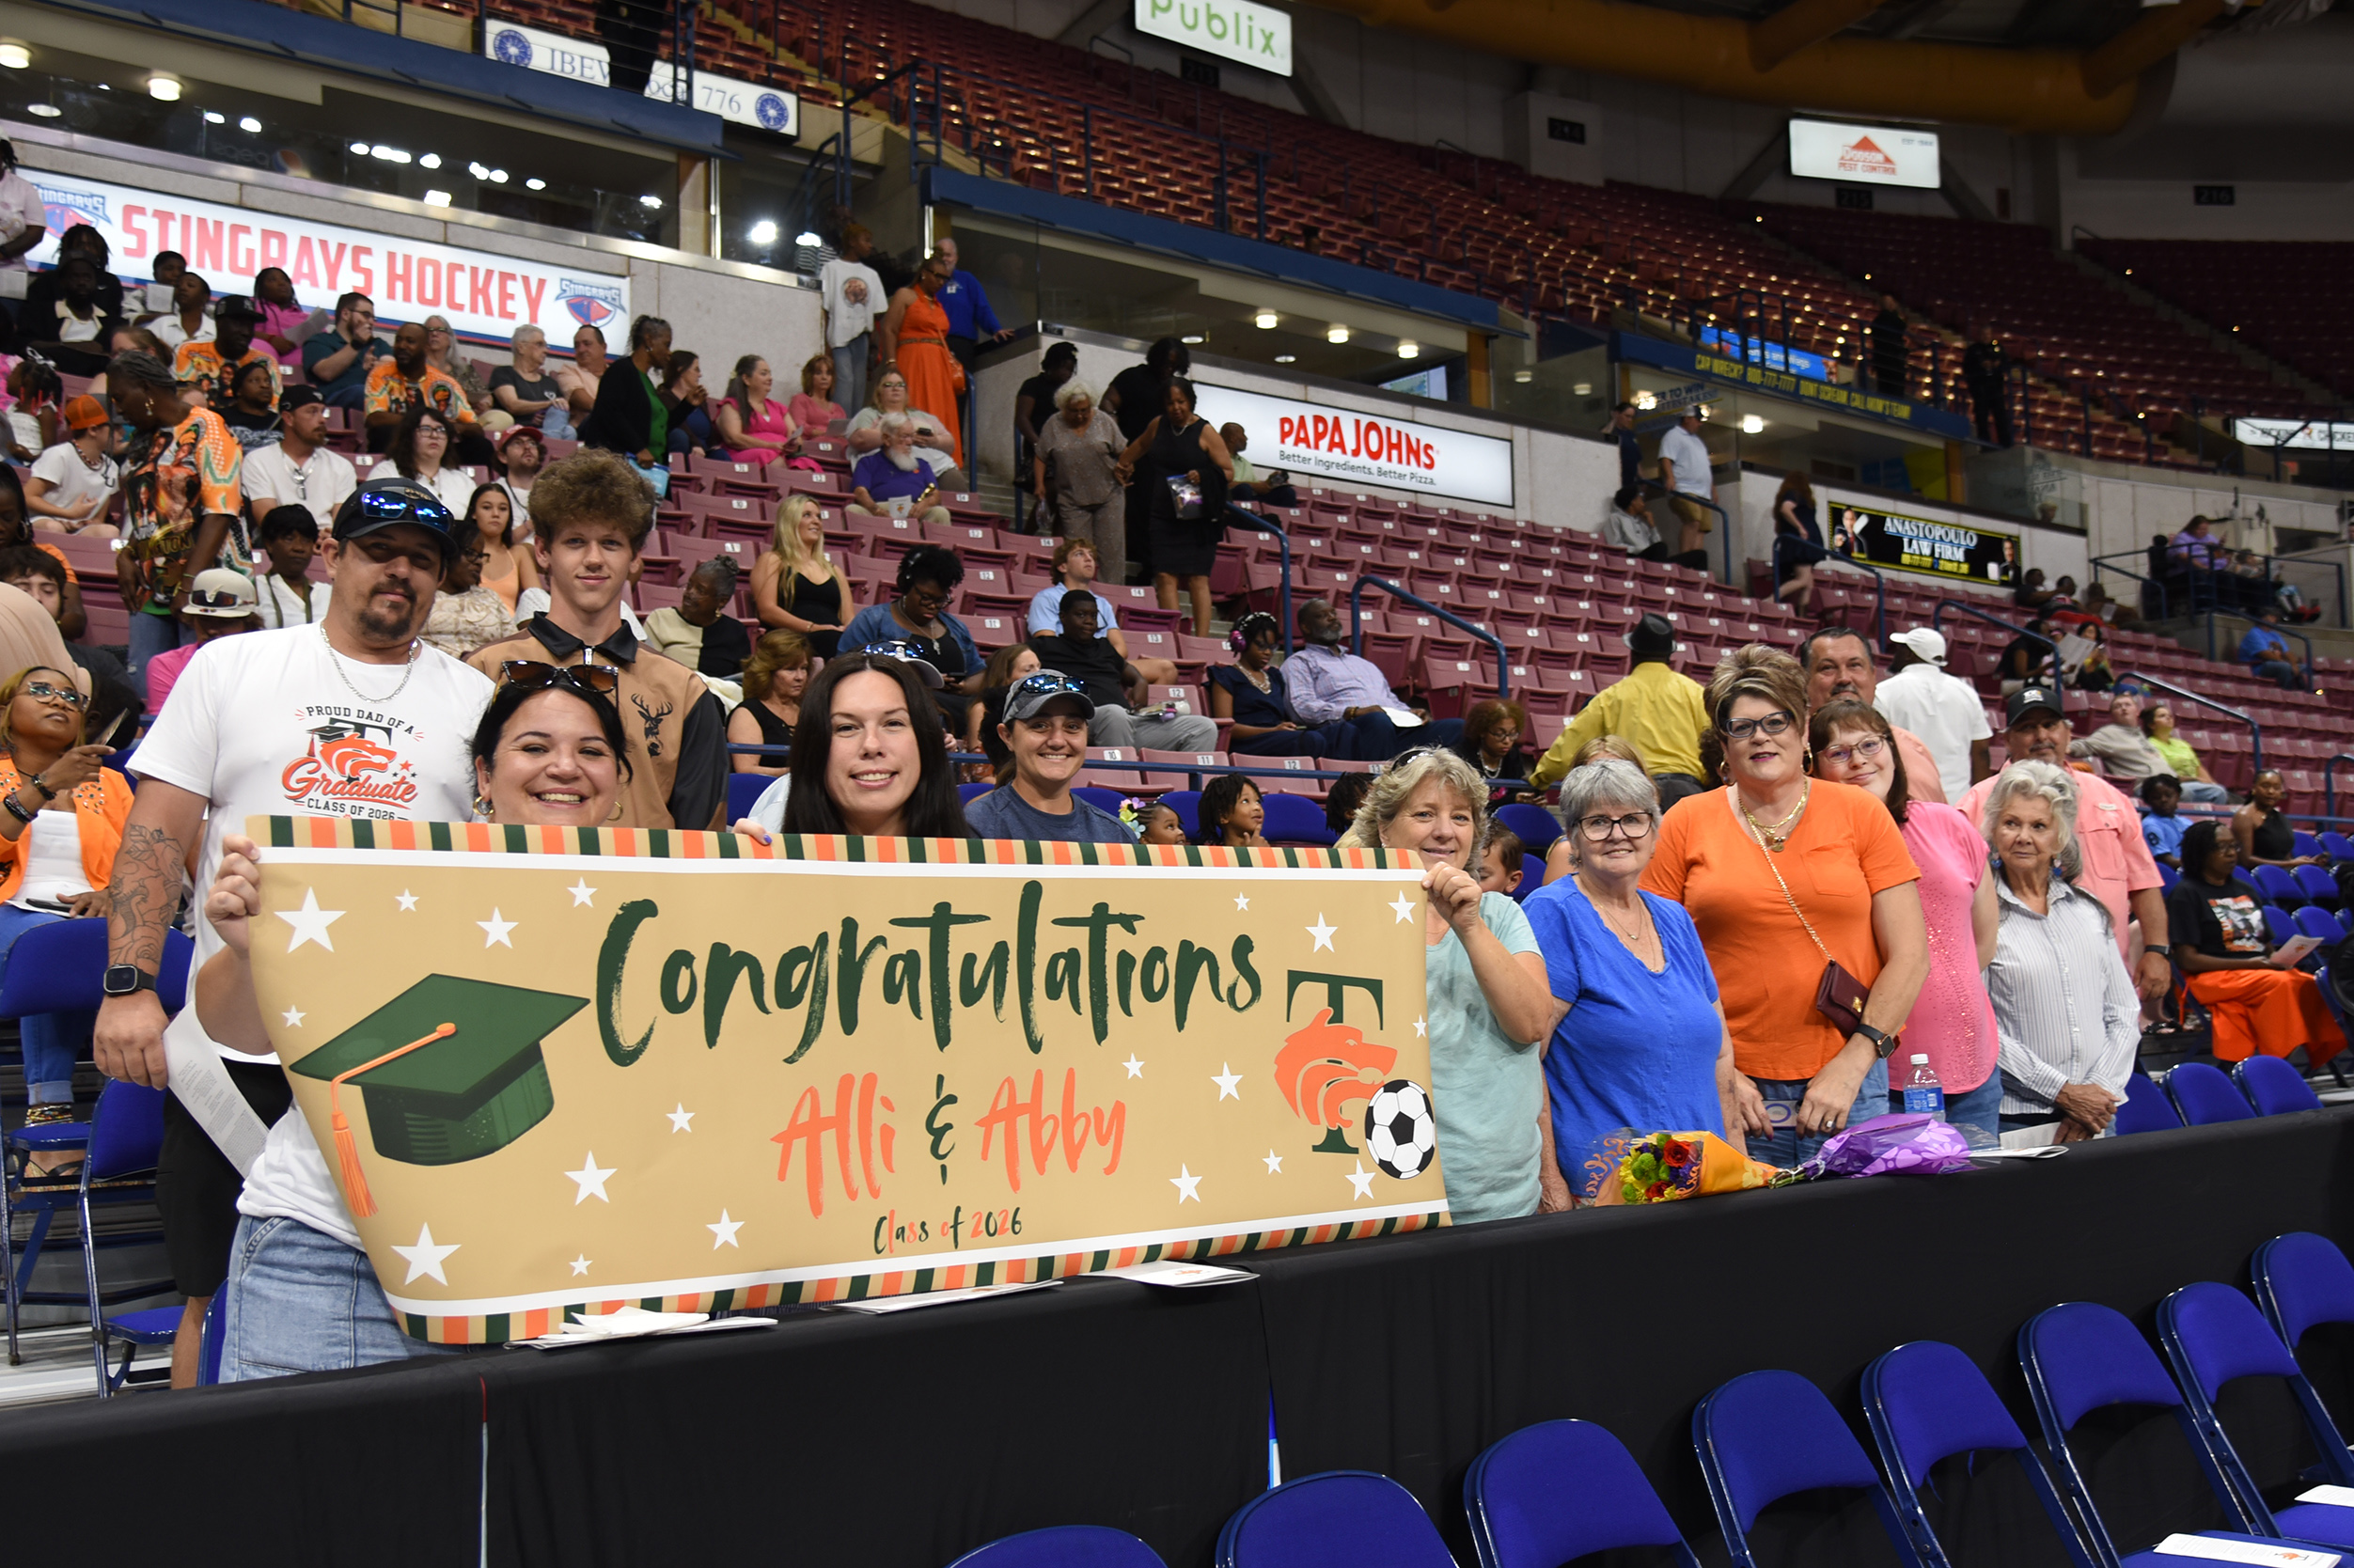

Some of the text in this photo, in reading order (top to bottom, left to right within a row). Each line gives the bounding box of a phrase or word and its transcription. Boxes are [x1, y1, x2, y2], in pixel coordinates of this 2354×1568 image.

[701, 86, 742, 115] 776
[1838, 163, 1897, 176] PEST CONTROL
[2200, 188, 2231, 203] 216
[122, 204, 547, 325] STINGRAYS HOCKEY
[1695, 353, 1711, 370] CAR
[1712, 358, 1745, 380] WRECK?
[1279, 415, 1436, 470] PAPA JOHNS
[1279, 450, 1437, 486] Better Ingredients. Better Pizza.
[896, 521, 904, 529] 12
[1884, 516, 1978, 547] ANASTOPOULO
[1903, 538, 1934, 557] LAW
[1934, 542, 1966, 562] FIRM
[983, 572, 992, 580] 12
[1151, 635, 1159, 643] 13
[1171, 689, 1181, 698] 12
[306, 705, 414, 734] PROUD DAD OF A
[1108, 751, 1117, 760] 10
[1201, 755, 1210, 764] 11
[1288, 760, 1297, 770] 12
[282, 756, 418, 803] Graduate
[1372, 764, 1381, 774] 13
[306, 798, 396, 820] CLASS OF 2026
[595, 879, 1262, 1067] Congratulations
[770, 1067, 1126, 1220] Alli & Abby
[873, 1206, 1023, 1254] Class of 2026
